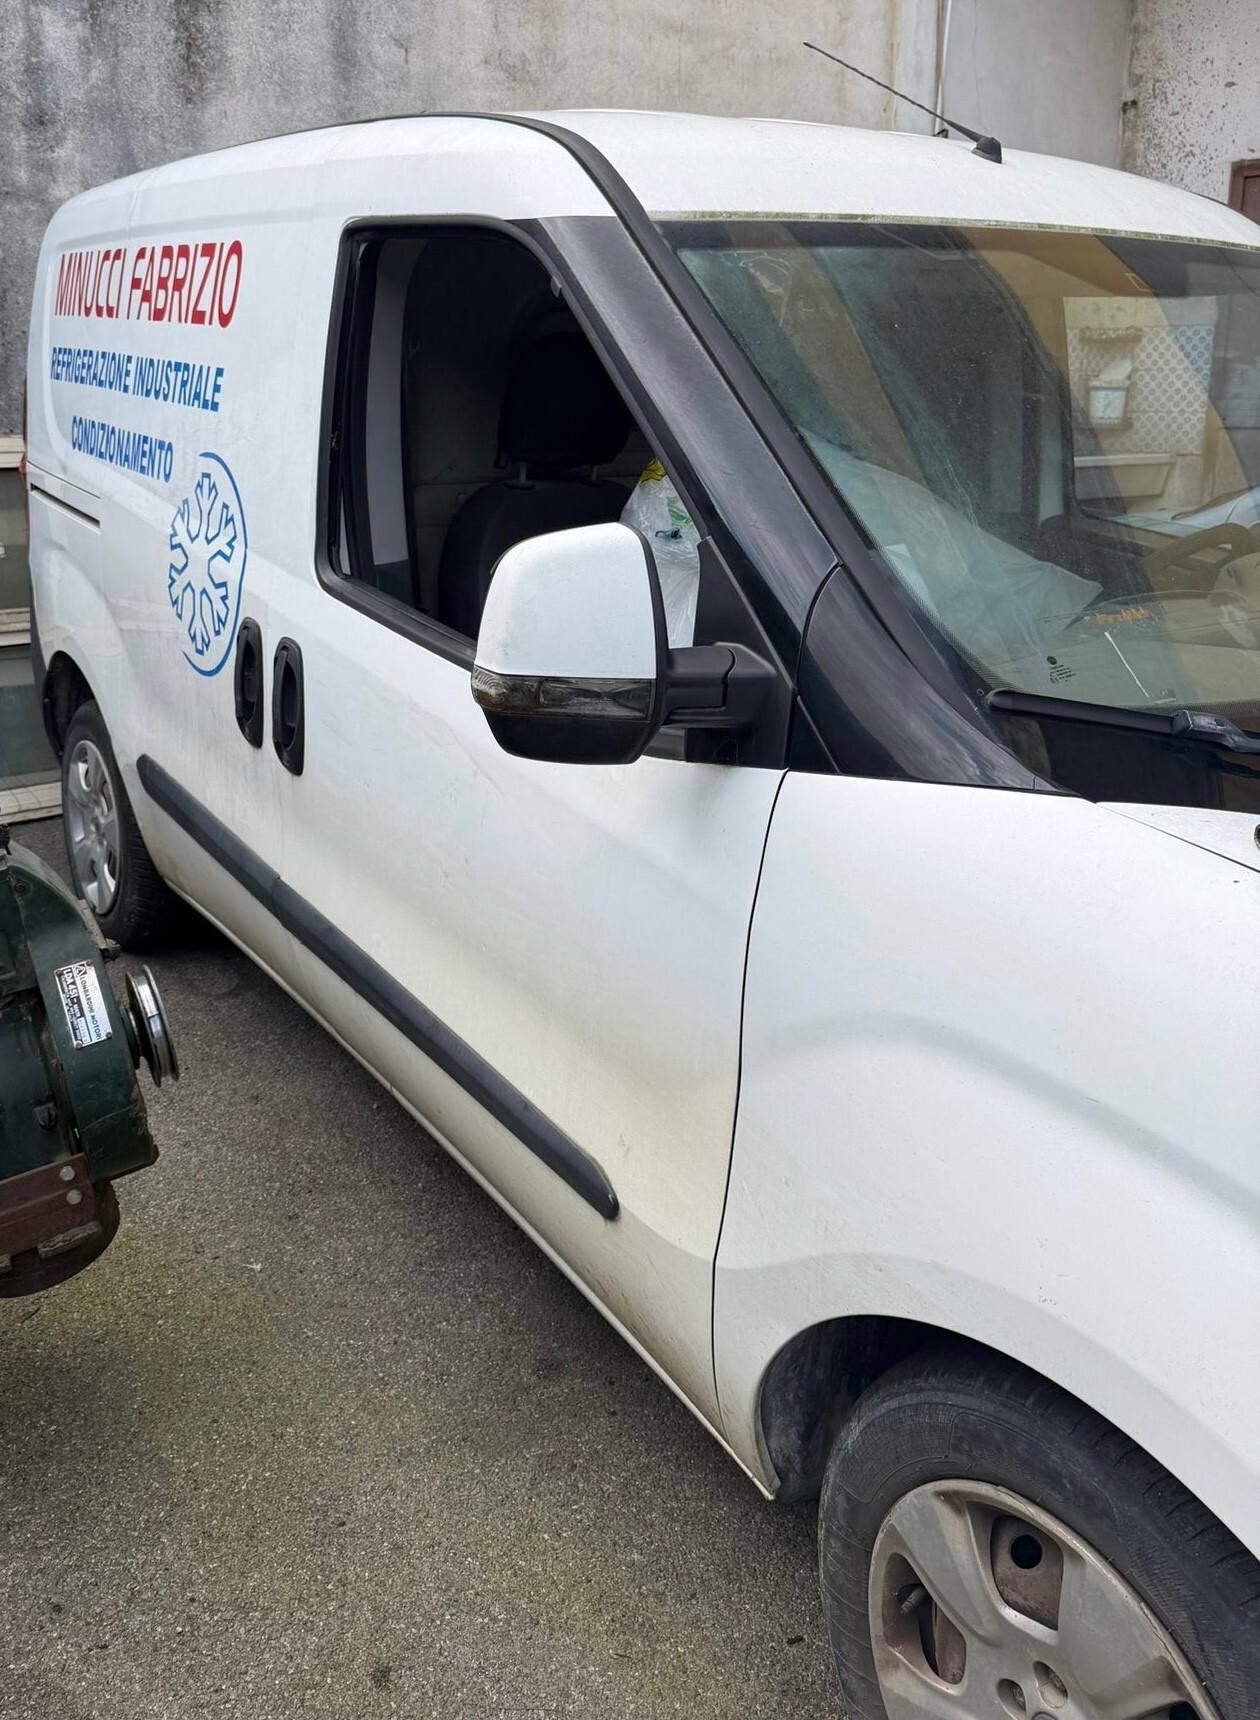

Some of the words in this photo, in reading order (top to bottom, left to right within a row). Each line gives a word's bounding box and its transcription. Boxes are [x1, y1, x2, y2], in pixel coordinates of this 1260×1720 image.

[54, 248, 127, 319] MINUCCI
[127, 240, 243, 329] FABRIZIO
[50, 346, 133, 393] REFRIGERAZIONE
[132, 357, 225, 412] INDUSTRIALE
[71, 416, 174, 483] CONDIZIONAMENTO
[63, 968, 74, 984] LDA
[90, 1014, 102, 1040] MOTORI
